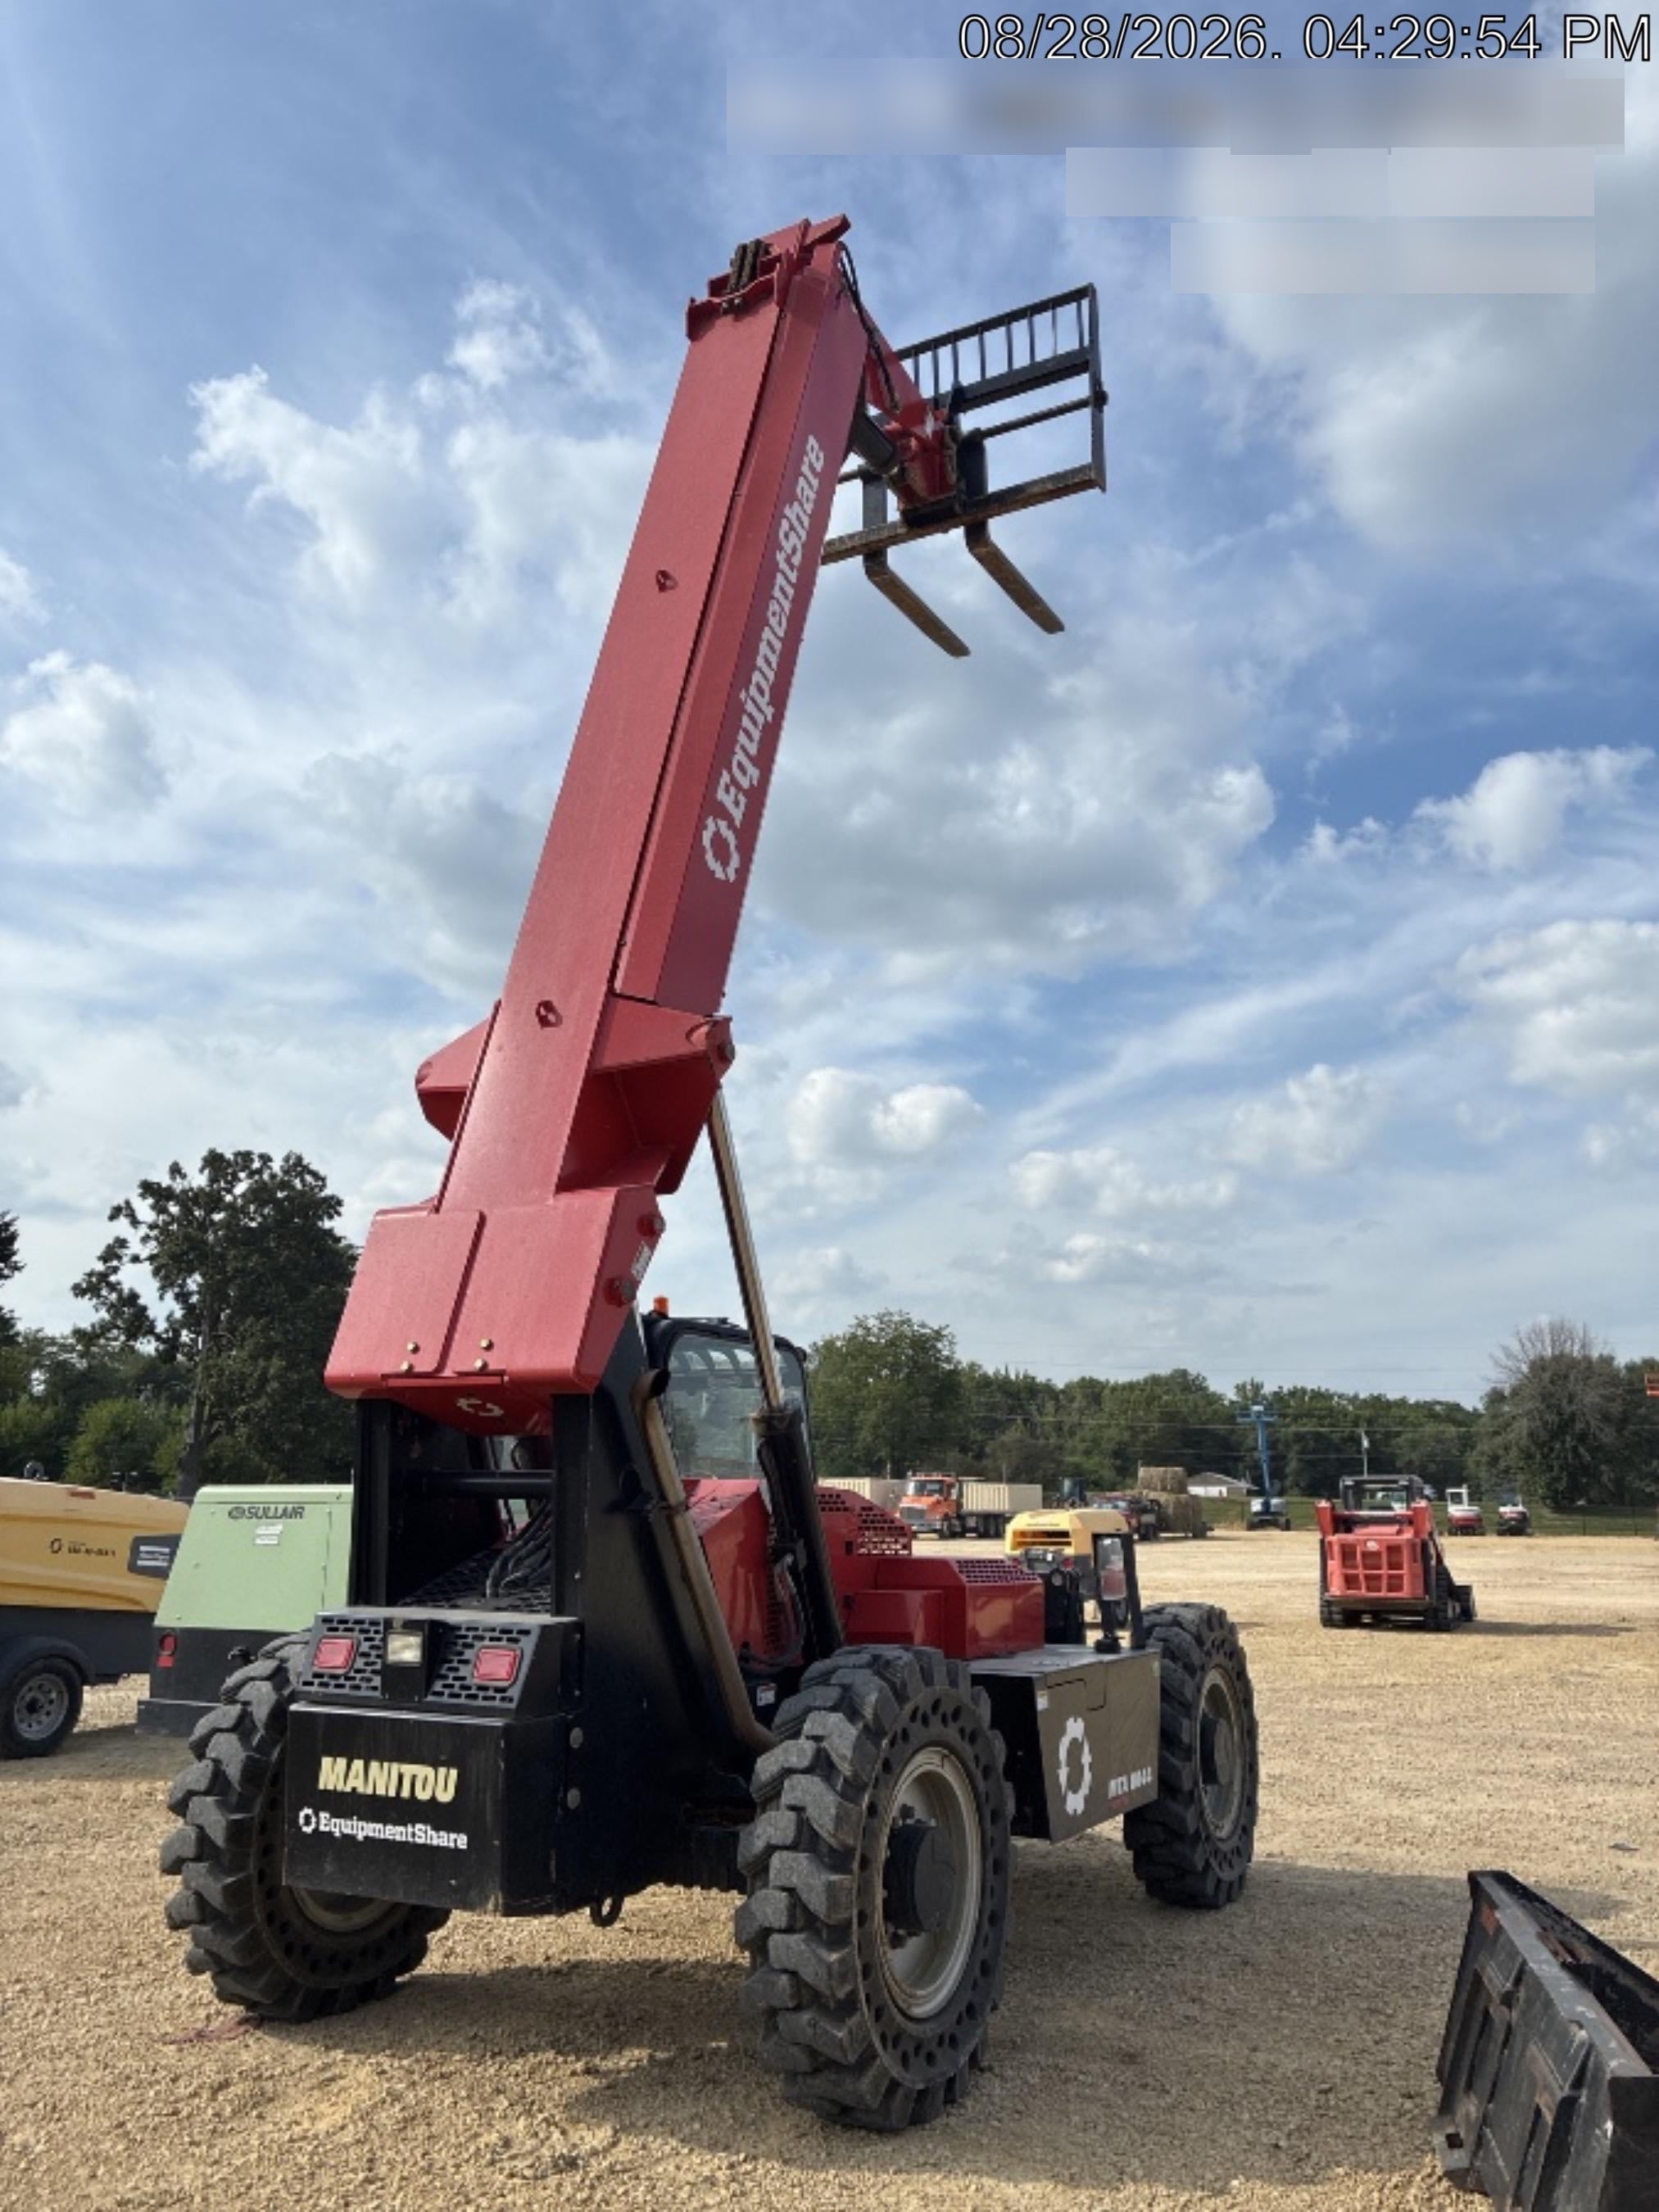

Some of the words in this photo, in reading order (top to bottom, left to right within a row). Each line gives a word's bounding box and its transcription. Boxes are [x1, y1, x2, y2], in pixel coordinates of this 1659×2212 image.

[717, 435, 825, 827] EquipmentShare
[247, 1506, 306, 1520] SULLAIR
[318, 1756, 458, 1802] MANITOU
[318, 1811, 468, 1849] EquipmentShare
